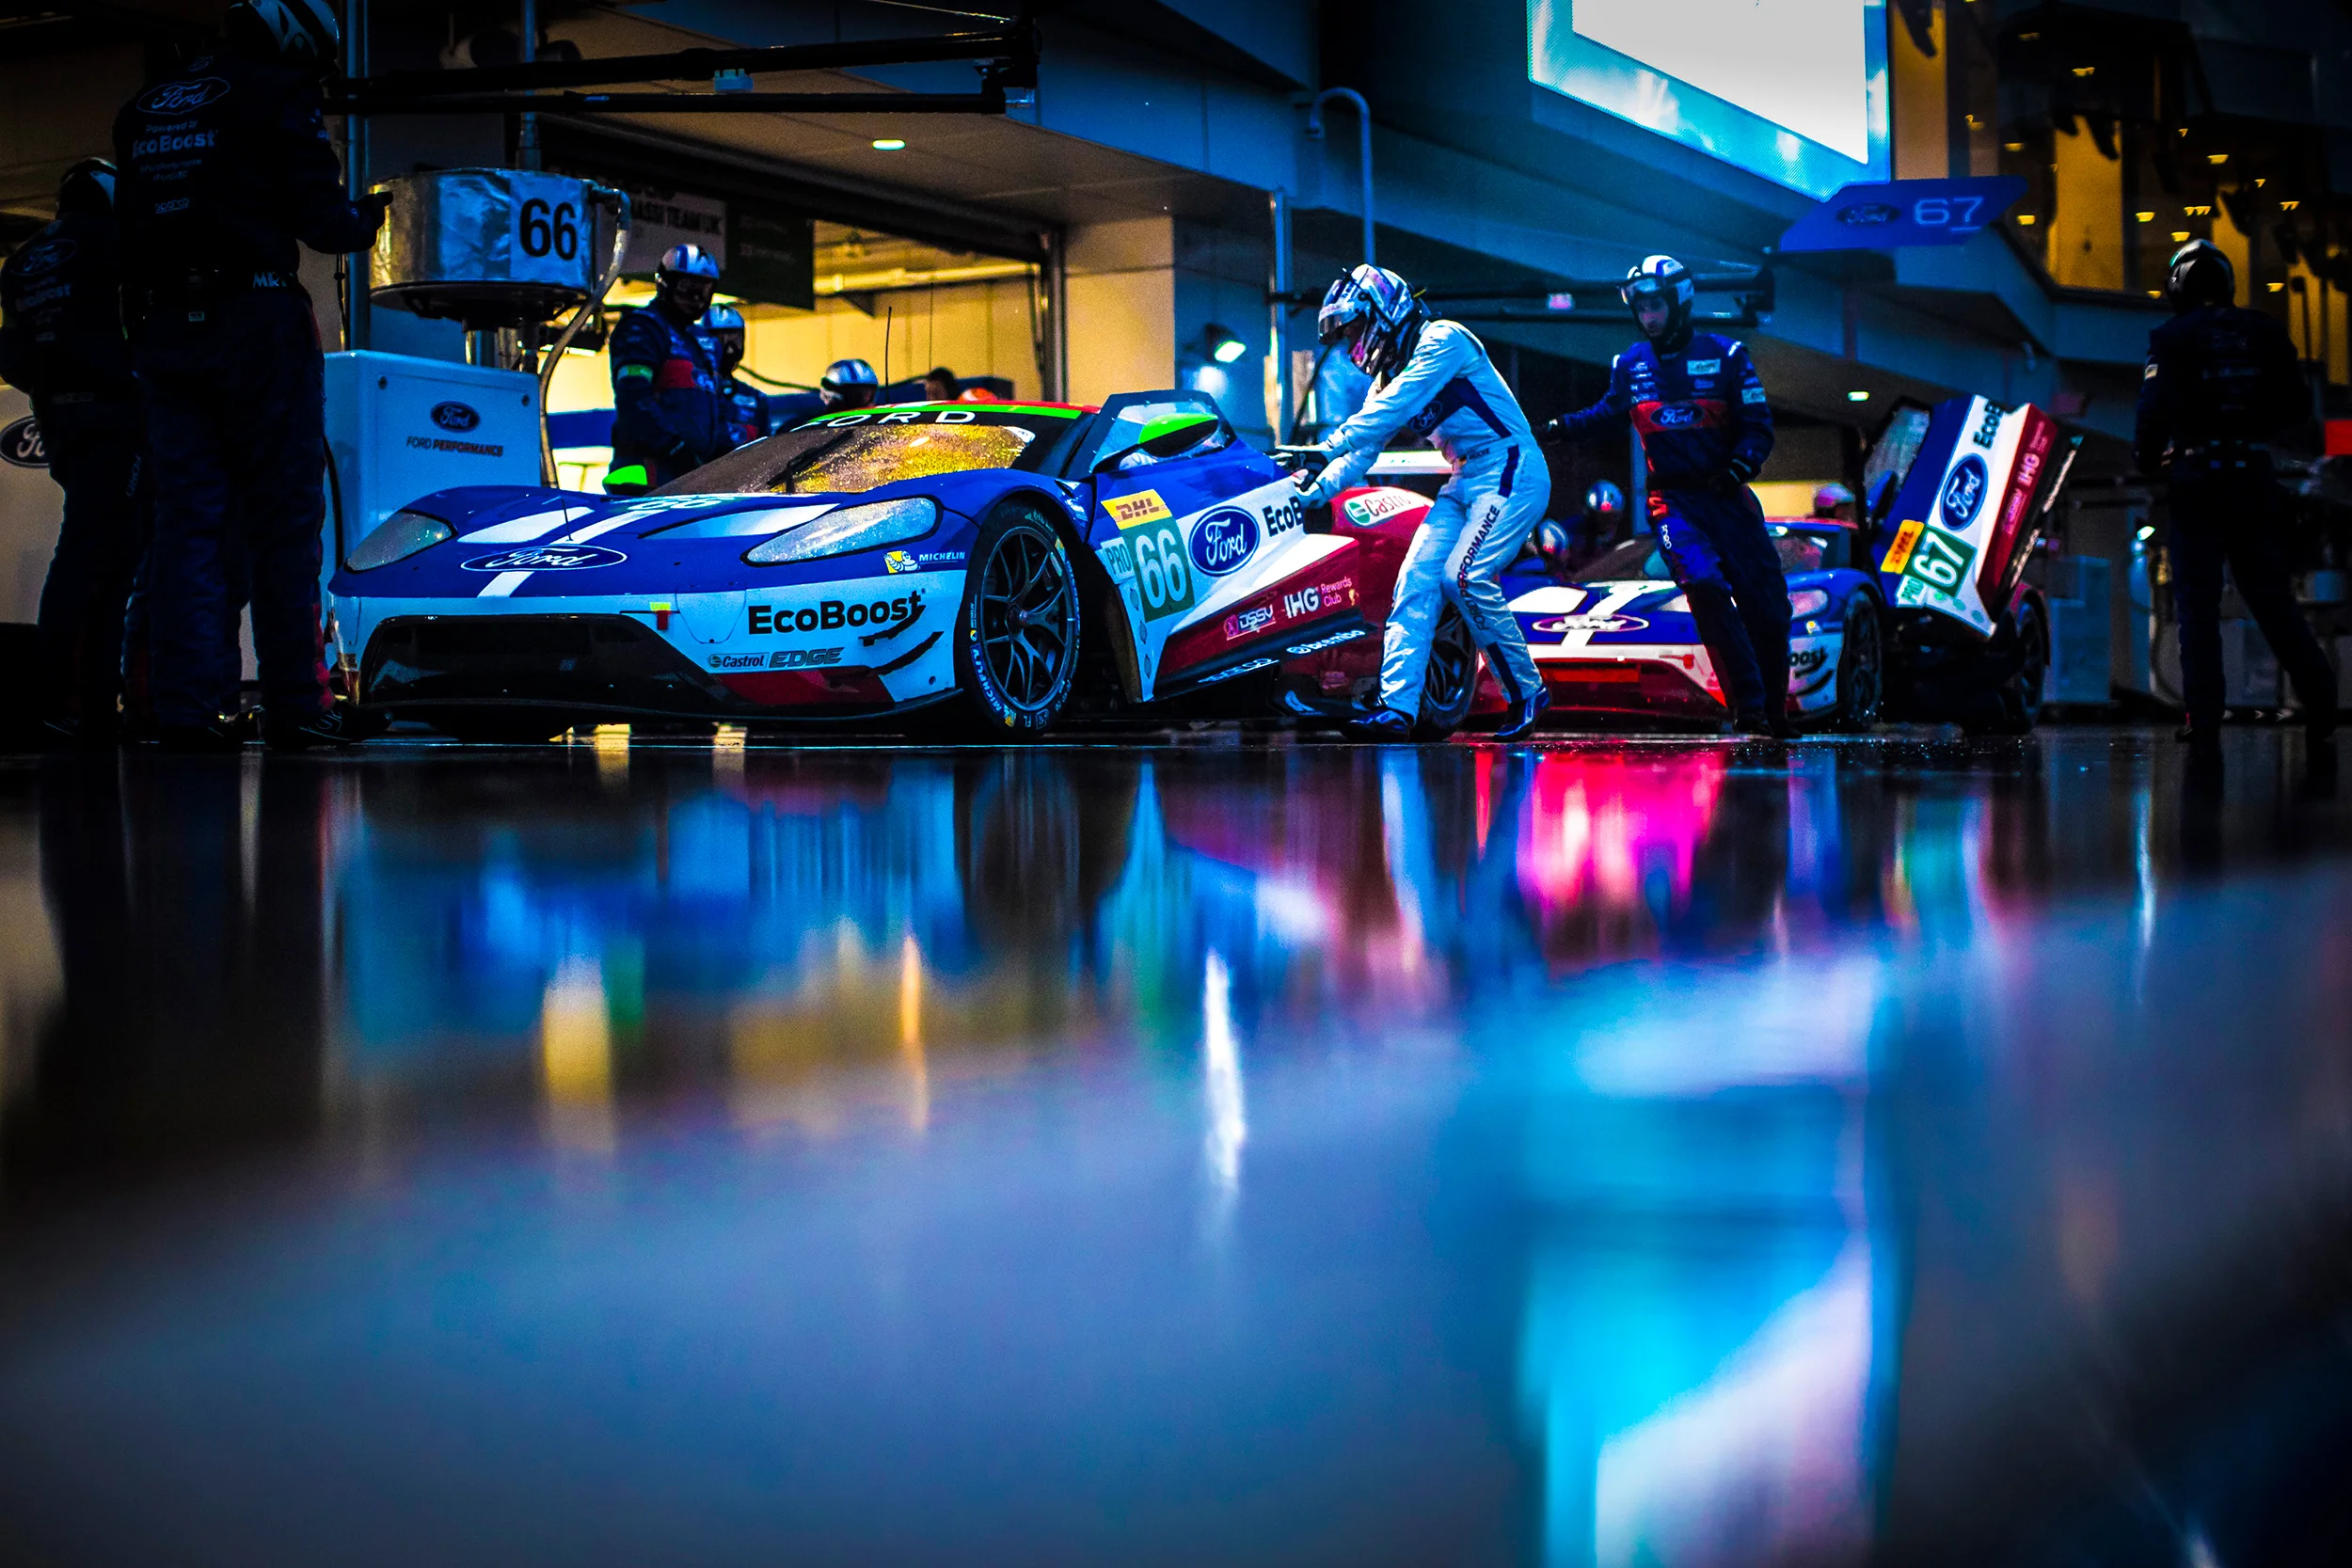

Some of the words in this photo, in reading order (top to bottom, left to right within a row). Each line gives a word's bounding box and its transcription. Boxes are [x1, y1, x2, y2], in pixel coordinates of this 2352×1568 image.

[151, 82, 214, 110] Ford
[1915, 195, 1984, 228] 67
[520, 198, 578, 261] 66
[439, 404, 472, 428] Ford
[1659, 407, 1695, 425] Ford
[1972, 399, 2006, 451] EcoB
[406, 436, 433, 450] FORD
[433, 438, 504, 458] PERFORMANCE
[1115, 498, 1161, 521] DHL
[1946, 466, 1981, 520] Ford
[1262, 496, 1304, 538] EcoB
[484, 547, 599, 568] Ford
[917, 550, 965, 563] MICHELIN
[1205, 517, 1248, 566] Ford
[1456, 504, 1502, 598] PERFORMANCE
[1104, 542, 1134, 576] PRO
[1136, 529, 1187, 609] 66
[1912, 530, 1964, 587] 67
[1283, 586, 1321, 619] IHG
[1320, 577, 1353, 600] Rewards
[1324, 593, 1343, 608] Club
[748, 590, 925, 635] EcoBoost
[1238, 604, 1275, 629] DSSV
[722, 656, 765, 669] Castrol
[771, 646, 845, 670] EDGE
